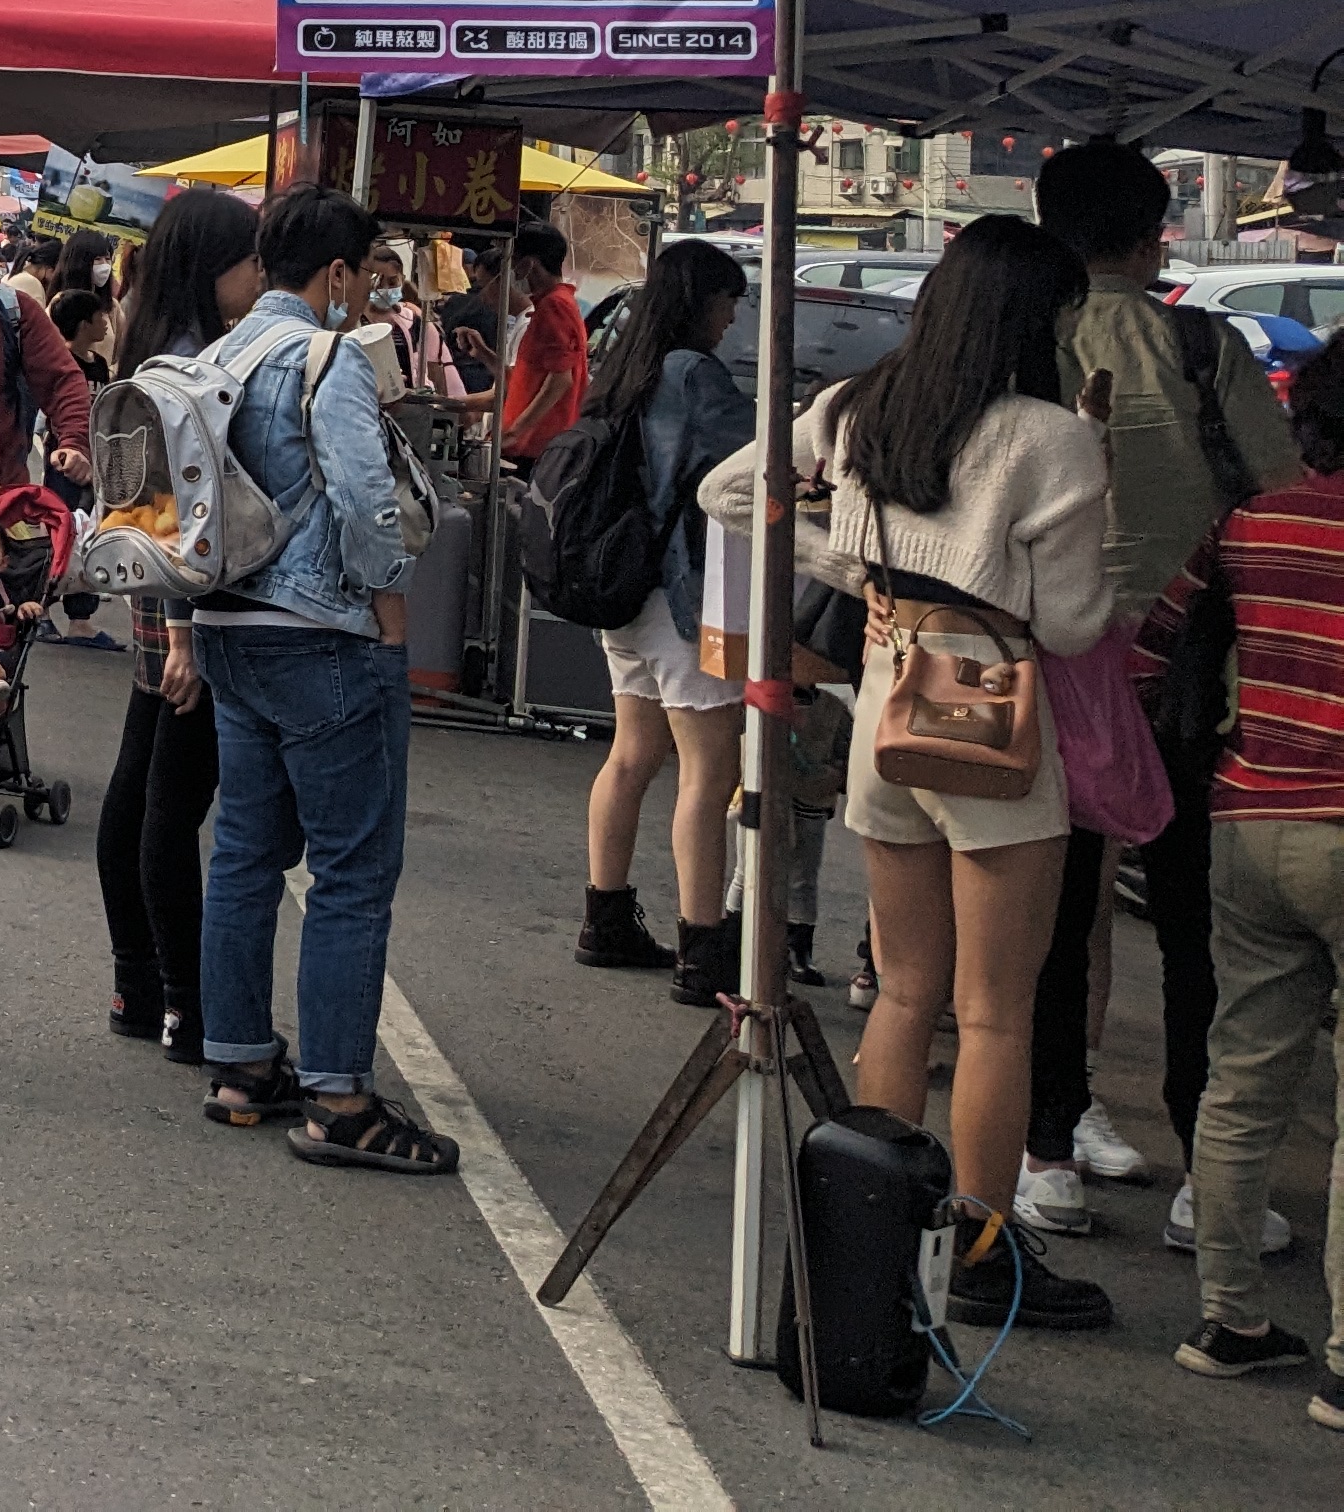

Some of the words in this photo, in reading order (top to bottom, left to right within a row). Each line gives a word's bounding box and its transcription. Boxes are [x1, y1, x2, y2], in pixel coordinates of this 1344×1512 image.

[354, 29, 435, 48] 純果熬製
[505, 30, 588, 49] 酸甜好喝
[618, 33, 681, 48] SINCE
[685, 33, 744, 48] 2014
[386, 117, 463, 148] 阿如
